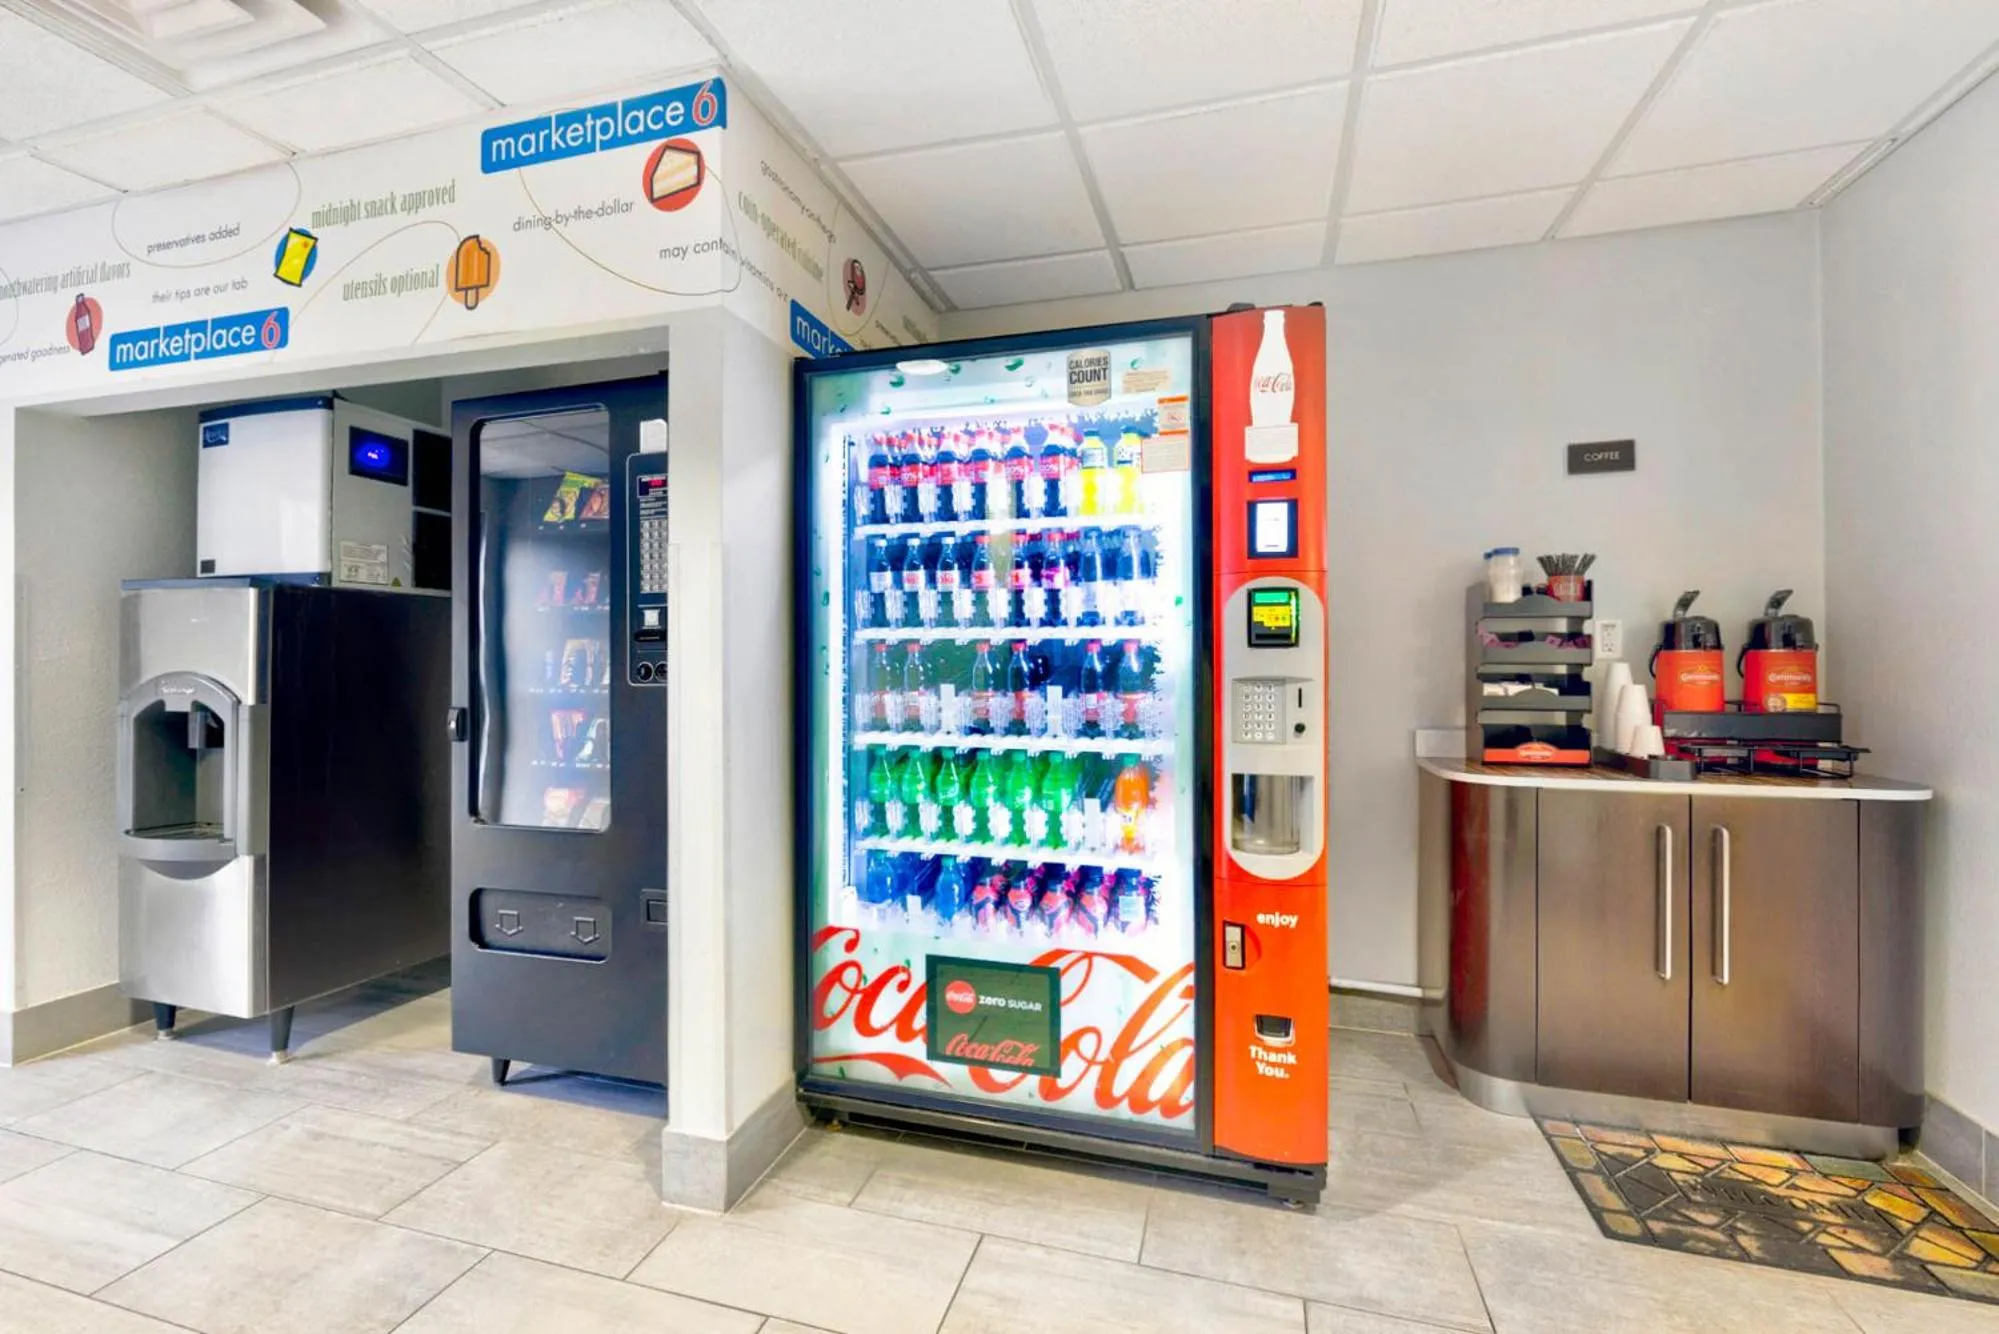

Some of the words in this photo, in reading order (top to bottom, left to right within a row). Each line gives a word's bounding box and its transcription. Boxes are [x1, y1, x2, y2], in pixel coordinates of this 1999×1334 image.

[491, 100, 685, 162] marketplace
[692, 80, 718, 126] 6
[312, 199, 361, 229] midnight
[364, 192, 397, 219] snack
[400, 179, 455, 215] approved
[147, 233, 206, 256] preservatives
[208, 222, 240, 241] added
[659, 245, 689, 261] may
[343, 272, 388, 301] utensils
[390, 264, 440, 297] optional
[176, 289, 191, 303] tips
[193, 285, 210, 297] are
[213, 283, 228, 294] our
[116, 318, 257, 363] marketplace
[261, 311, 281, 350] 6
[1069, 356, 1109, 370] CALORIES
[1069, 368, 1108, 385] COUNT
[1583, 451, 1620, 462] COFFEE
[1257, 911, 1299, 929] enjoy
[1007, 999, 1043, 1012] SUGAR
[1248, 1044, 1298, 1066] Thank
[1255, 1060, 1291, 1079] You.
